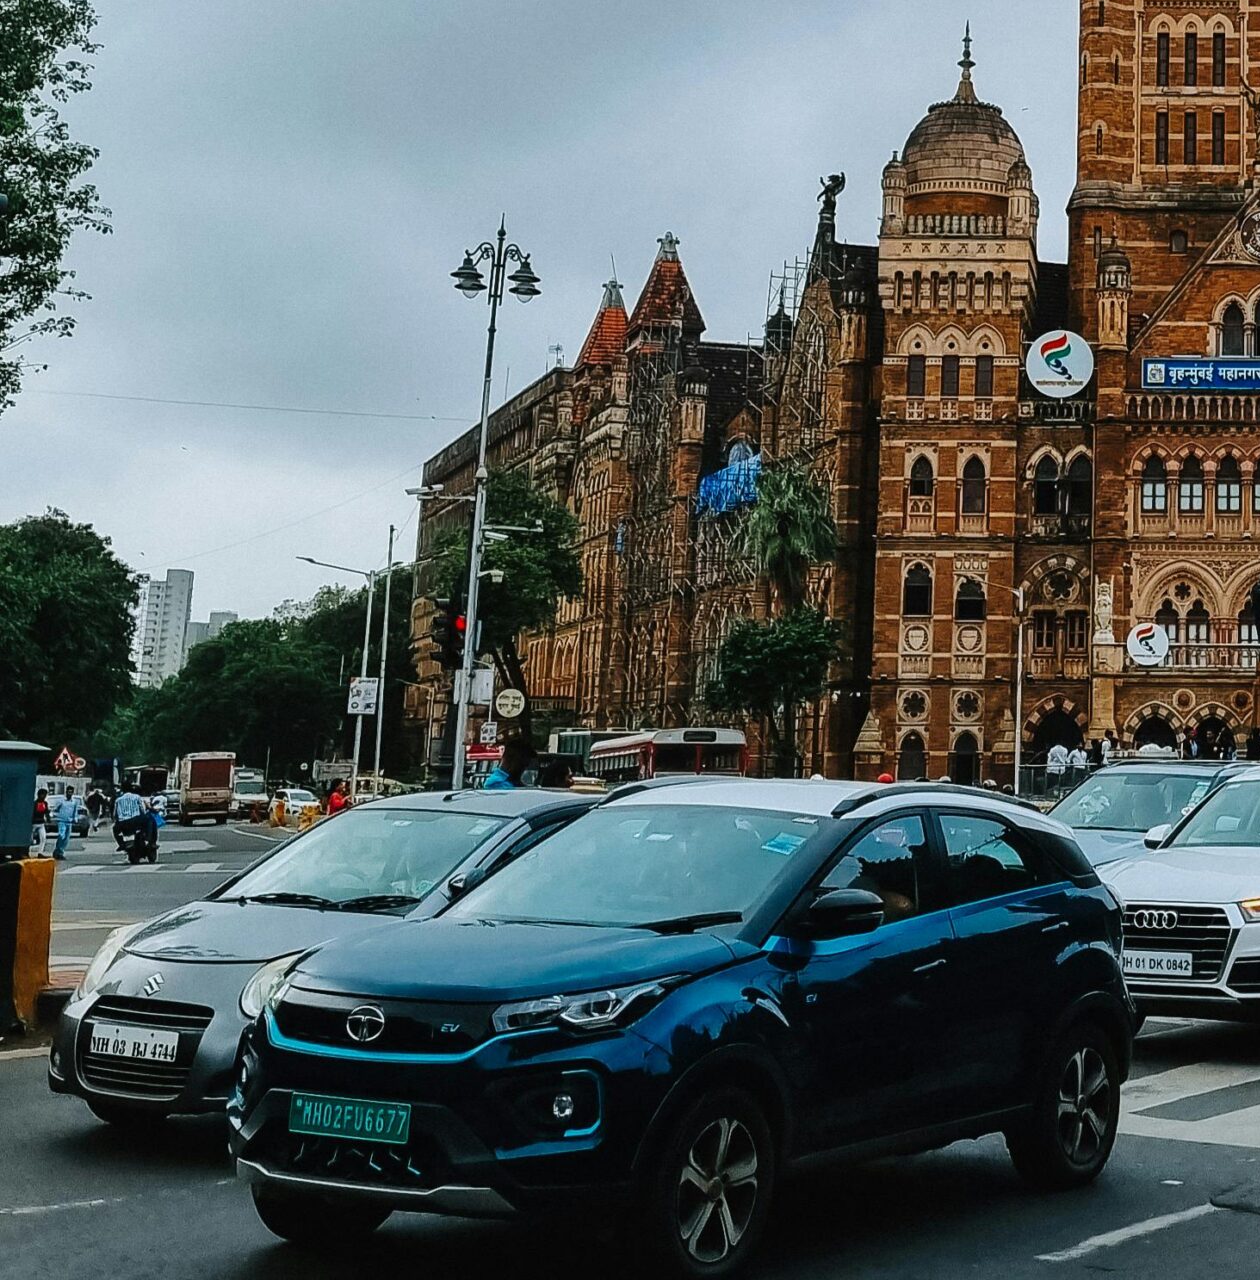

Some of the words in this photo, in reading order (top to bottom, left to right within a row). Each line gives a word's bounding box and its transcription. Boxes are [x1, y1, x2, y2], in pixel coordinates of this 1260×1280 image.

[1168, 363, 1213, 385] बृहन्मुंबई
[1135, 957, 1145, 969] 01
[1149, 958, 1164, 970] DK
[1166, 959, 1191, 971] 0842
[440, 1023, 460, 1033] EV
[92, 1036, 110, 1053] MH
[112, 1038, 127, 1055] 03
[150, 1043, 176, 1061] 4744
[302, 1101, 408, 1136] MH02FU6677
